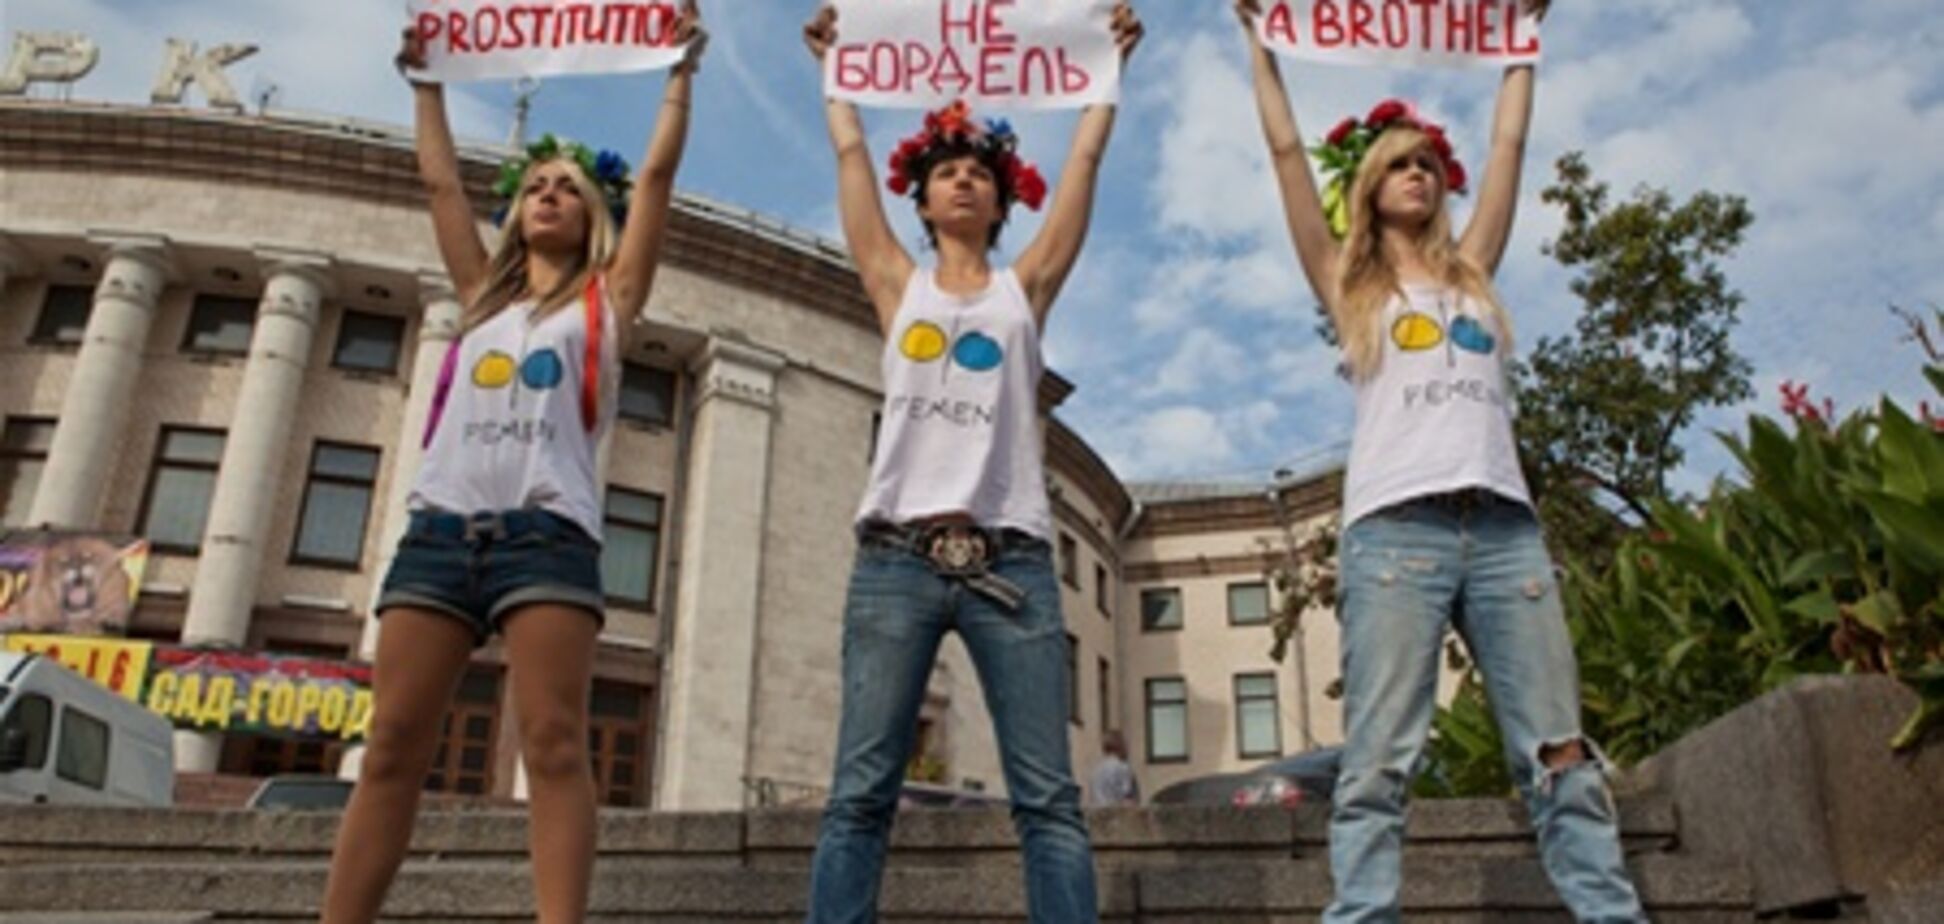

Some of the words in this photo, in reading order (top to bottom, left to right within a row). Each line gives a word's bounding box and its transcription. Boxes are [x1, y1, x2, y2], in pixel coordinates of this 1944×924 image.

[940, 0, 1017, 43] НЕ
[1265, 2, 1297, 45] A
[1312, 0, 1540, 56] BROTHEL
[836, 39, 1091, 95] БОРДЕЛЬ
